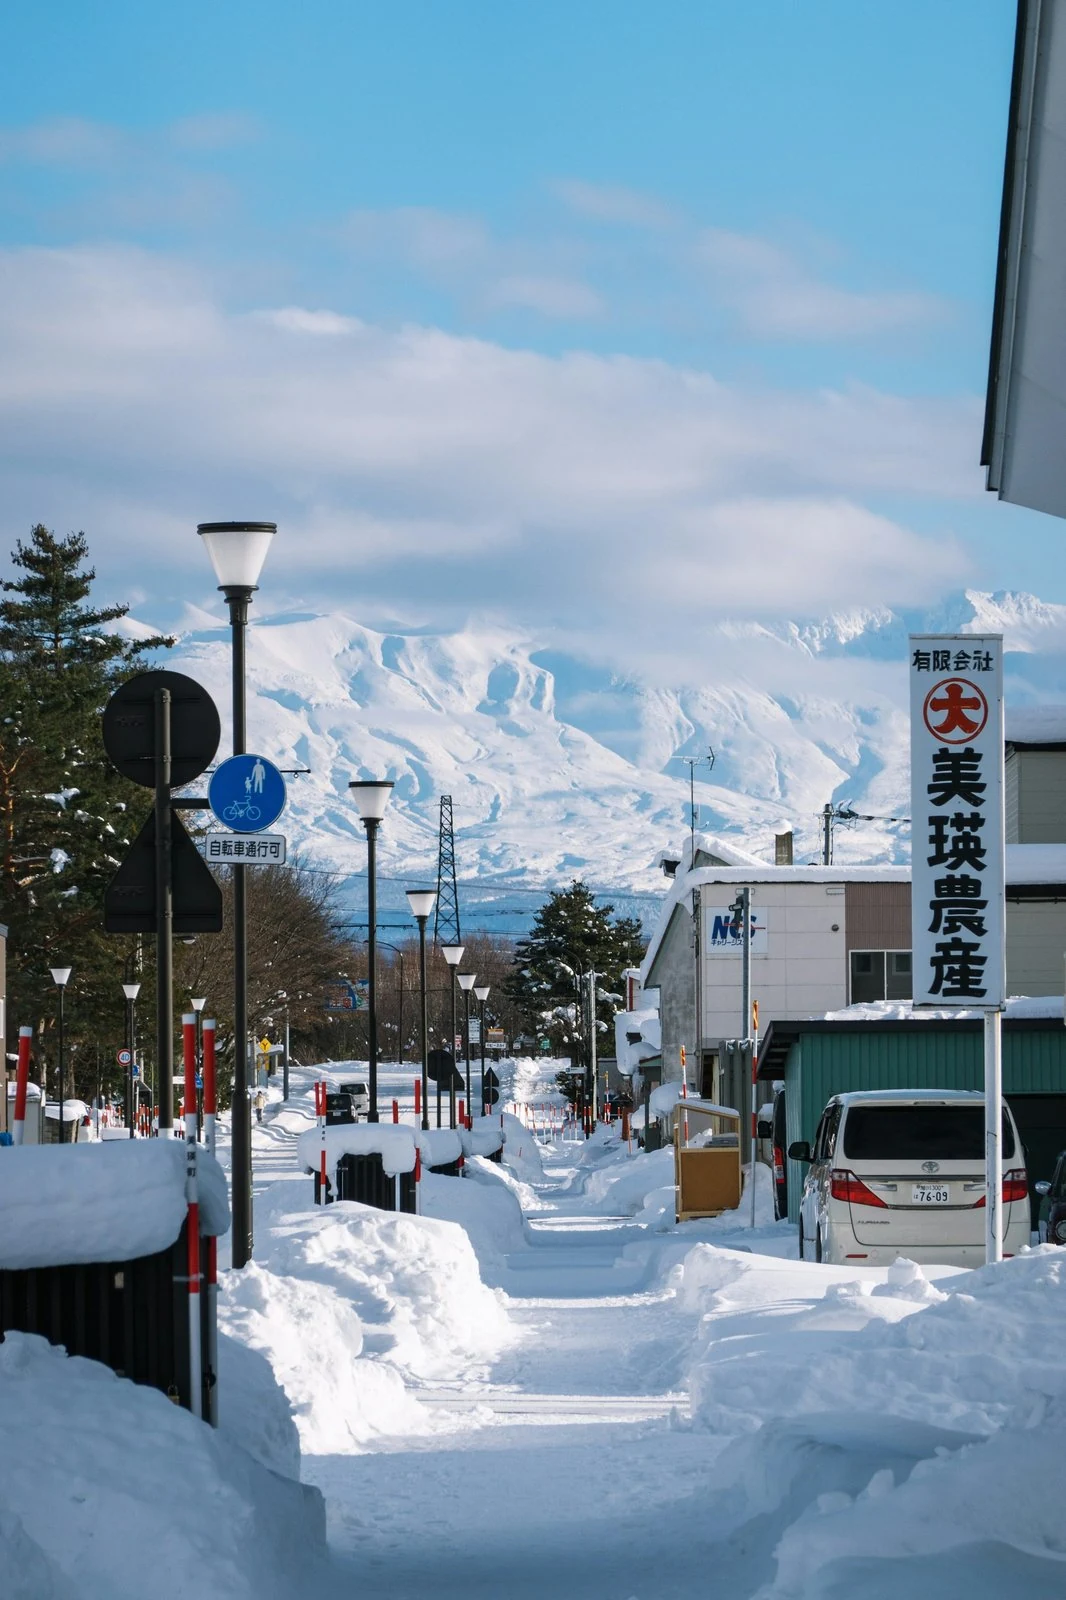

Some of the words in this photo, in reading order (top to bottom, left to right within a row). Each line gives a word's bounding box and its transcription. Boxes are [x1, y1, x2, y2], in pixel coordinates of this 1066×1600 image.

[912, 649, 994, 672] 有限会社
[930, 683, 981, 734] 大
[210, 840, 280, 858] 自転車通行可
[927, 747, 989, 998] 美瑛農産
[120, 1053, 130, 1061] 40
[919, 1191, 948, 1202] 76-09
